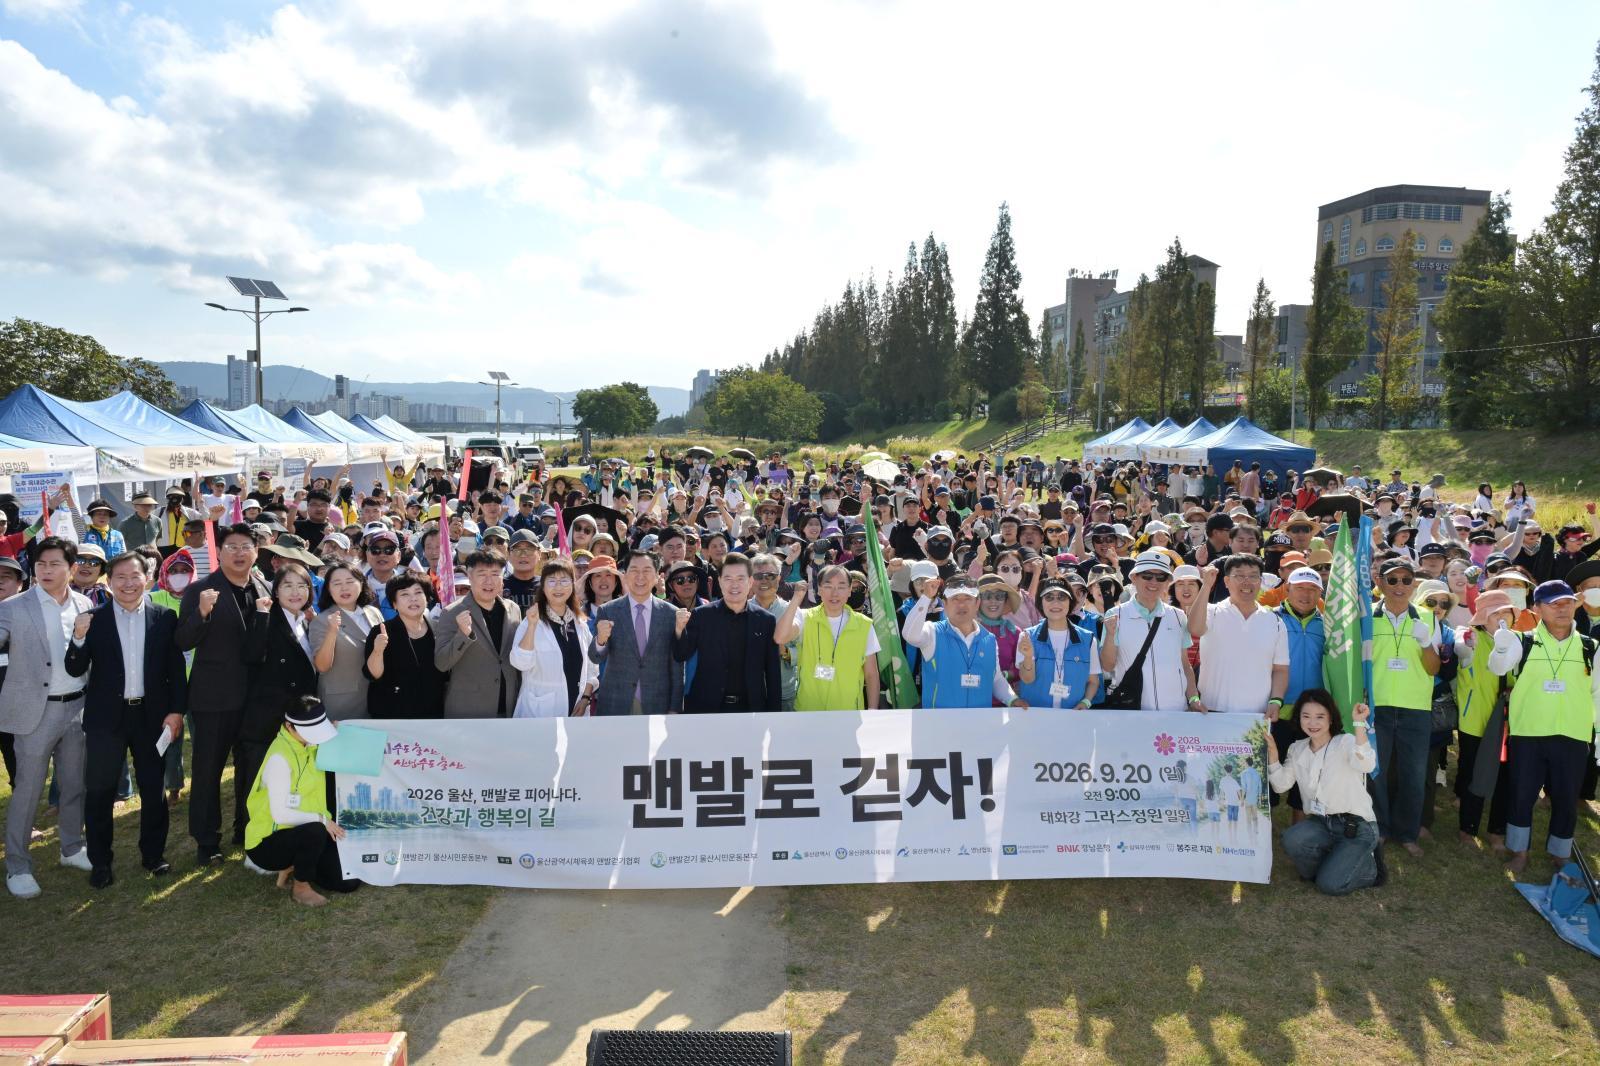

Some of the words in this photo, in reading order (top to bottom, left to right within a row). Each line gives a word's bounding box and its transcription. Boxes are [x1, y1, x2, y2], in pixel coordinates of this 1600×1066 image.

[1341, 383, 1358, 394] 부동산
[169, 452, 185, 469] 삼육
[1178, 736, 1200, 745] 2028
[1178, 744, 1252, 755] 울산국제정원박람회
[1159, 766, 1185, 783] (일)
[407, 788, 444, 800] 2026
[448, 788, 477, 804] 울산,
[481, 788, 521, 803] 맨발로
[525, 788, 581, 803] 피어나다.
[622, 757, 820, 828] 맨발로
[839, 752, 996, 822] 걷자!
[1083, 791, 1102, 802] 오전
[1104, 788, 1141, 802] 9:00
[420, 806, 472, 828] 건강과
[477, 807, 532, 828] 행복의
[538, 807, 556, 828] 길
[1040, 810, 1081, 824] 태화강
[1084, 808, 1162, 824] 그라스정원
[1164, 808, 1190, 823] 일원
[1056, 844, 1080, 853] BNK
[1080, 844, 1111, 853] 경남은행
[1176, 843, 1198, 853] 봉주르
[1199, 844, 1213, 854] 치과
[402, 853, 431, 862] 맨발걷기
[433, 853, 488, 863] 울산시민운동본부
[536, 857, 595, 866] 울산광역시체육회
[597, 857, 641, 866] 맨발걷기협회
[668, 855, 698, 864] 맨발걷기
[699, 852, 758, 864] 울산시민운동본부
